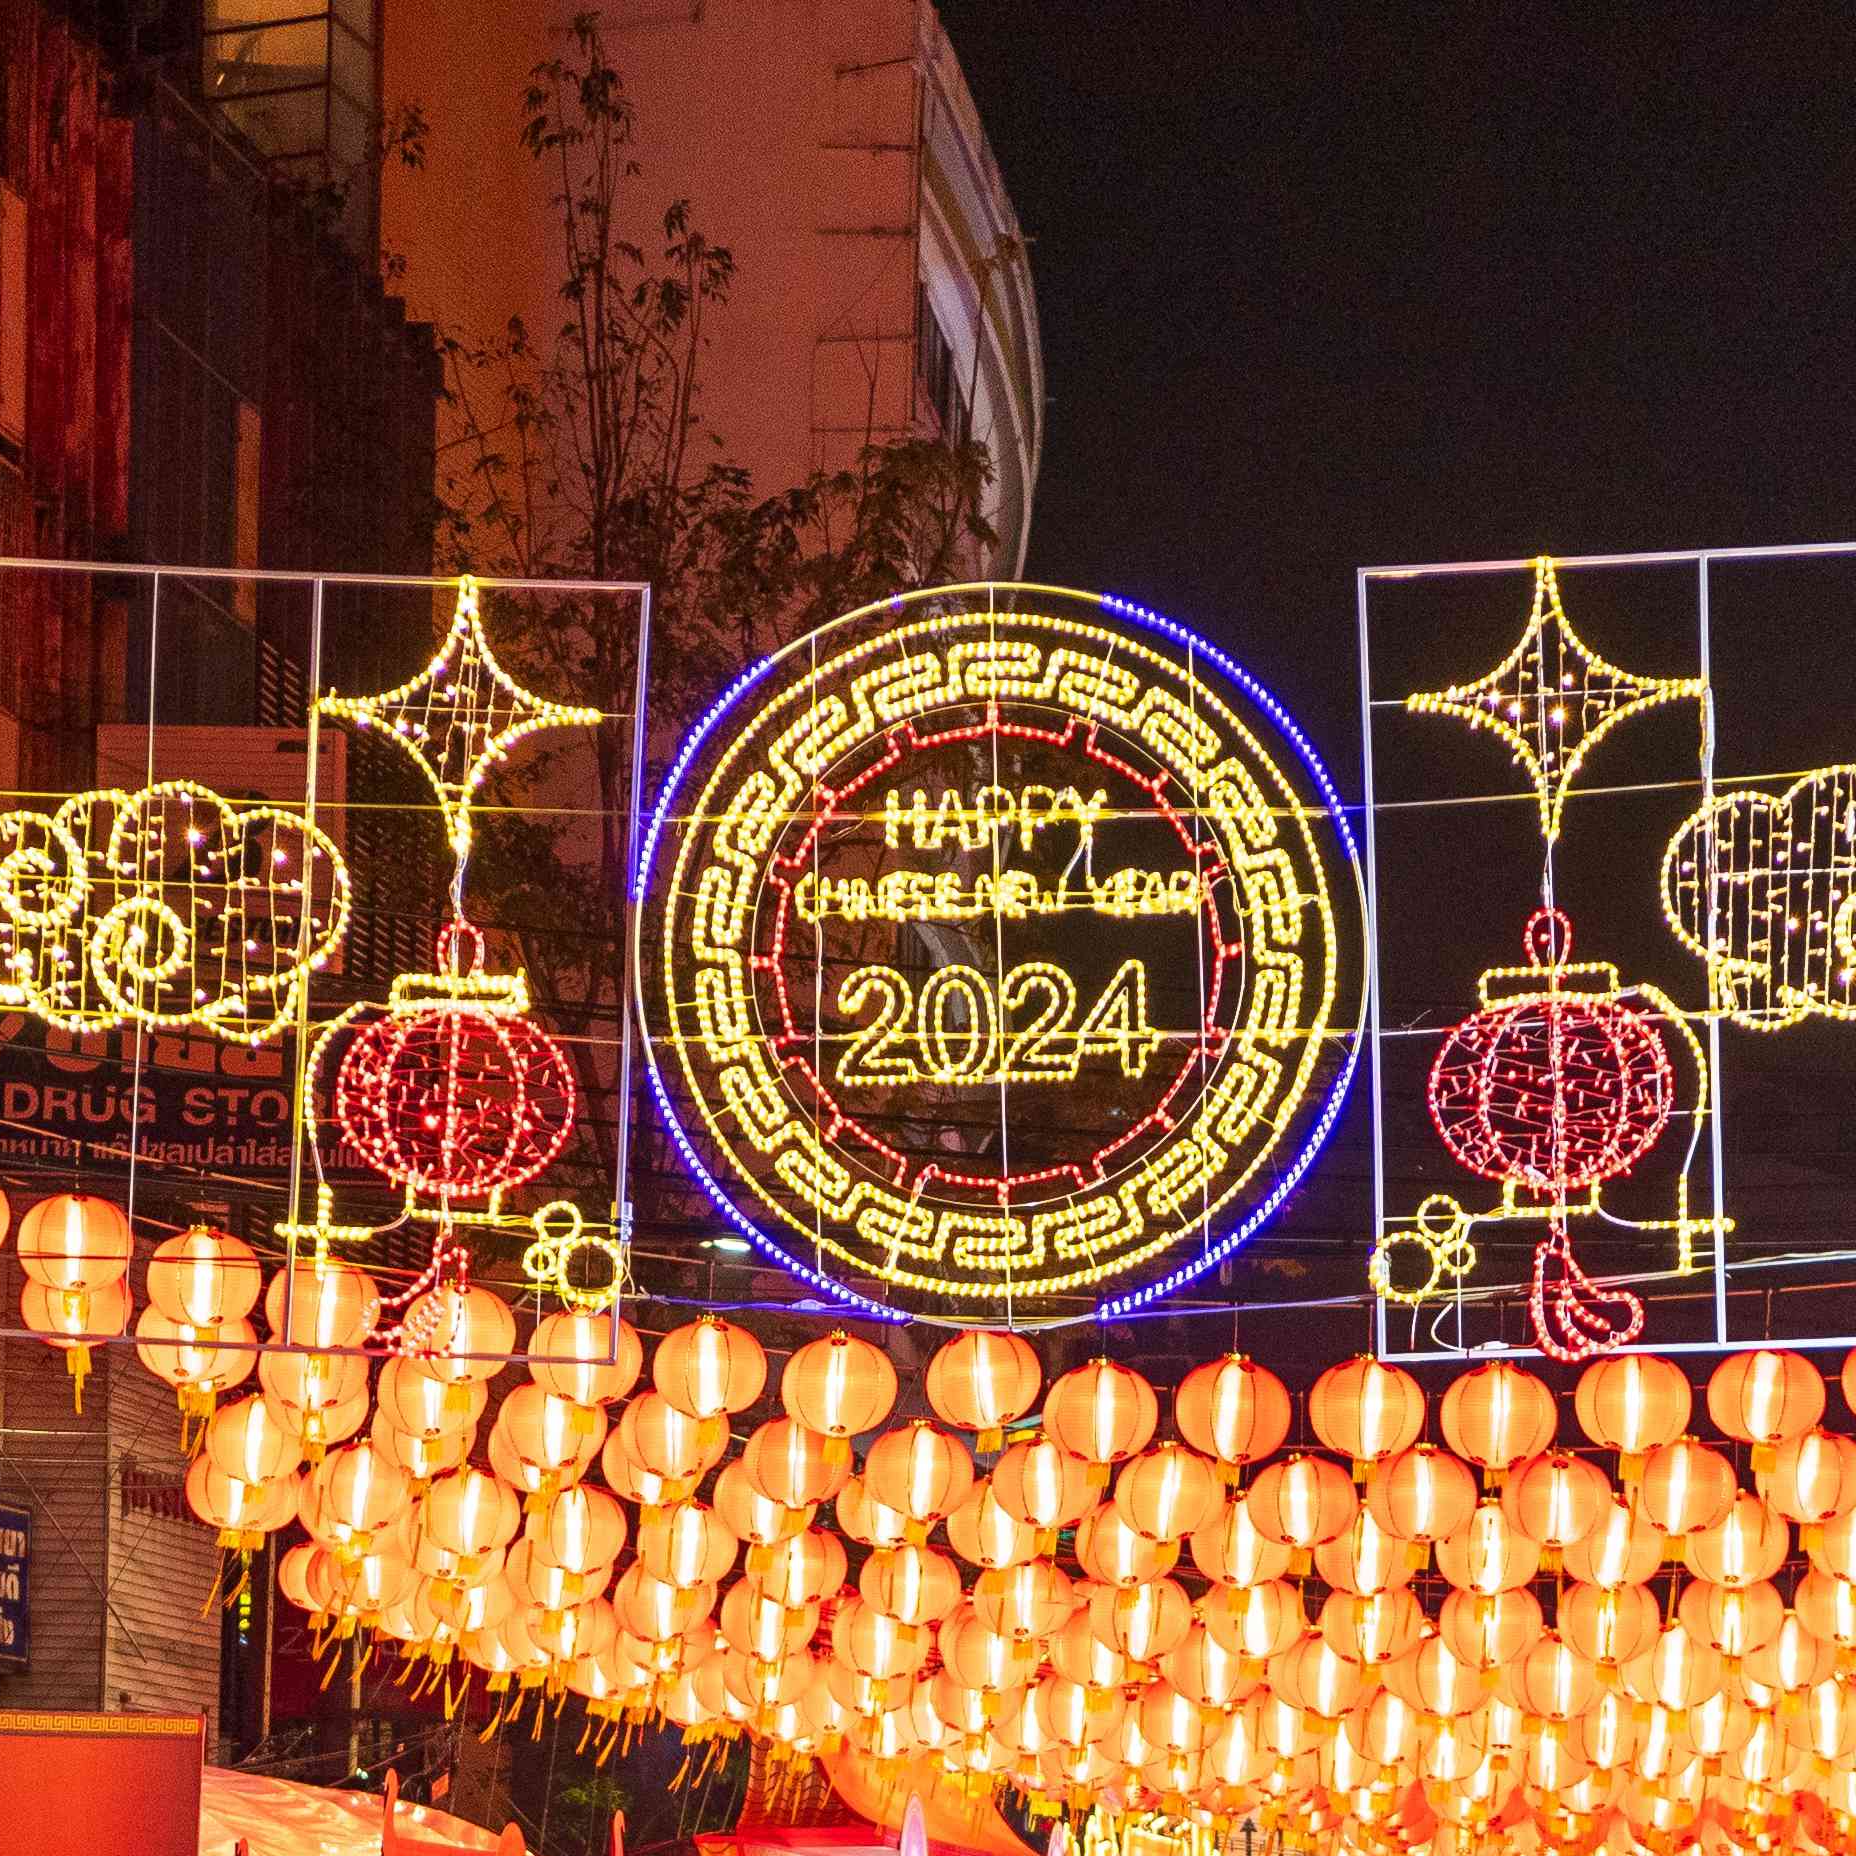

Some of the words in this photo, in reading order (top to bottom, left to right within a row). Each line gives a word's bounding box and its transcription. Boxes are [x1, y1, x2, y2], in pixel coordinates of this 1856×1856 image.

[885, 785, 1107, 851] HAPPY
[835, 959, 1161, 1085] 2024
[3, 1082, 157, 1124] DRUG
